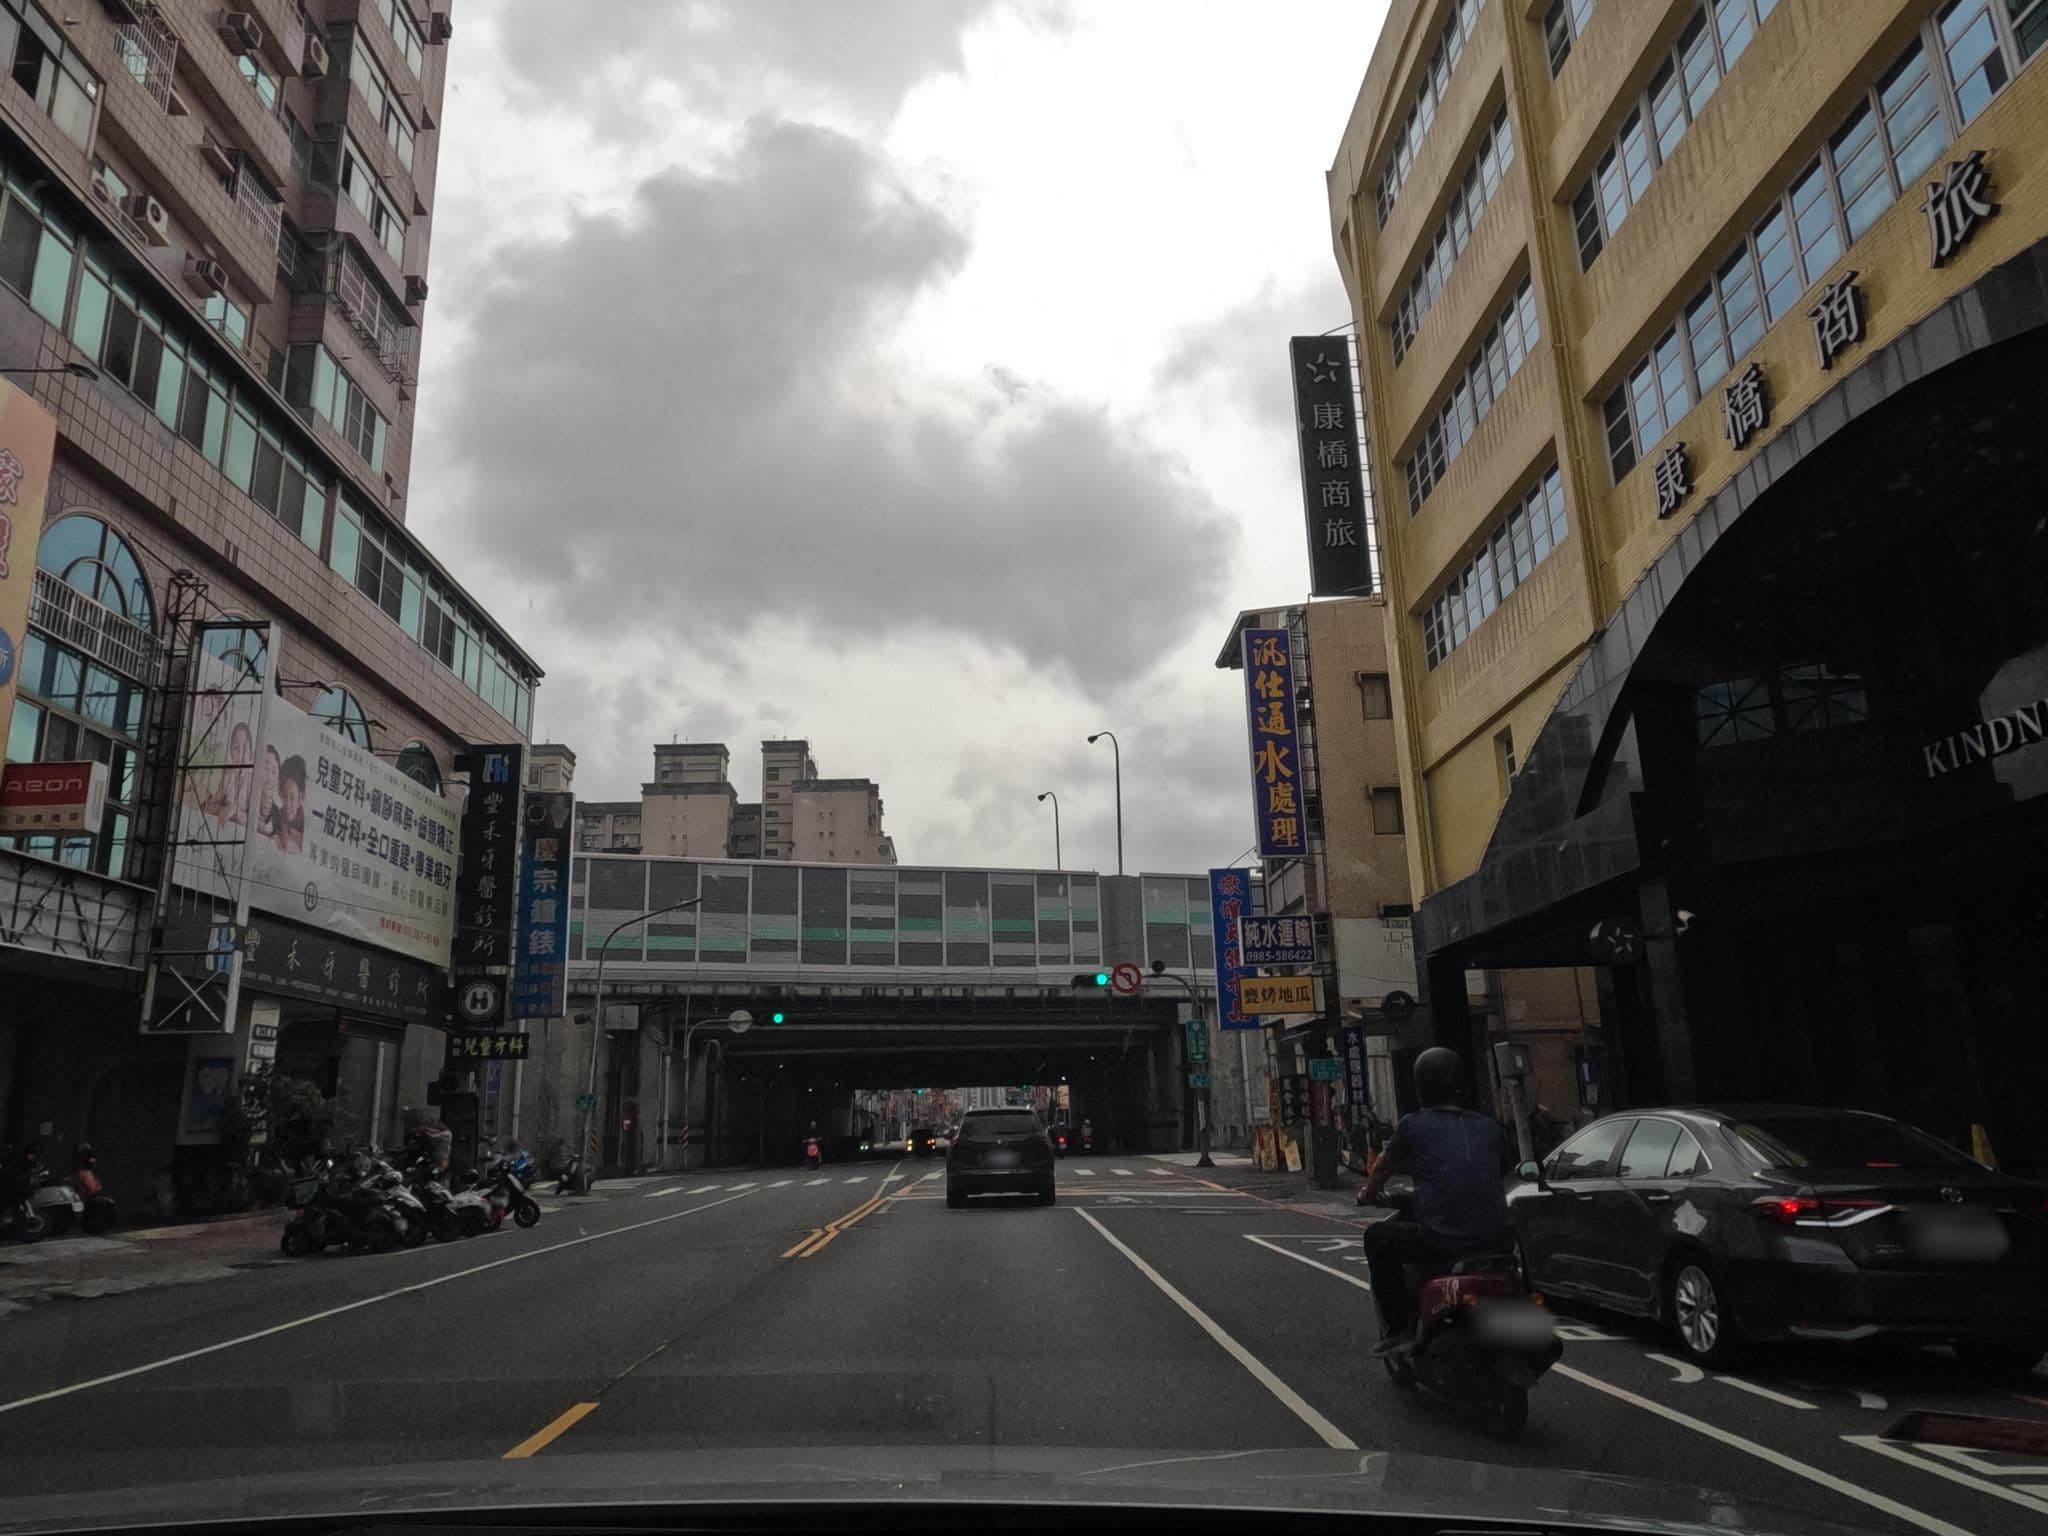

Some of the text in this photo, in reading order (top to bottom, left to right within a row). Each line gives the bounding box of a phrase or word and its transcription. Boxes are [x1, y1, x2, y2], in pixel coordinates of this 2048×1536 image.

[1653, 150, 1999, 519] 康橋商旅
[1313, 402, 1357, 548] 康橋商旅
[472, 791, 504, 956] 豐禾牙醫診所
[1245, 917, 1312, 948] 純水運輸
